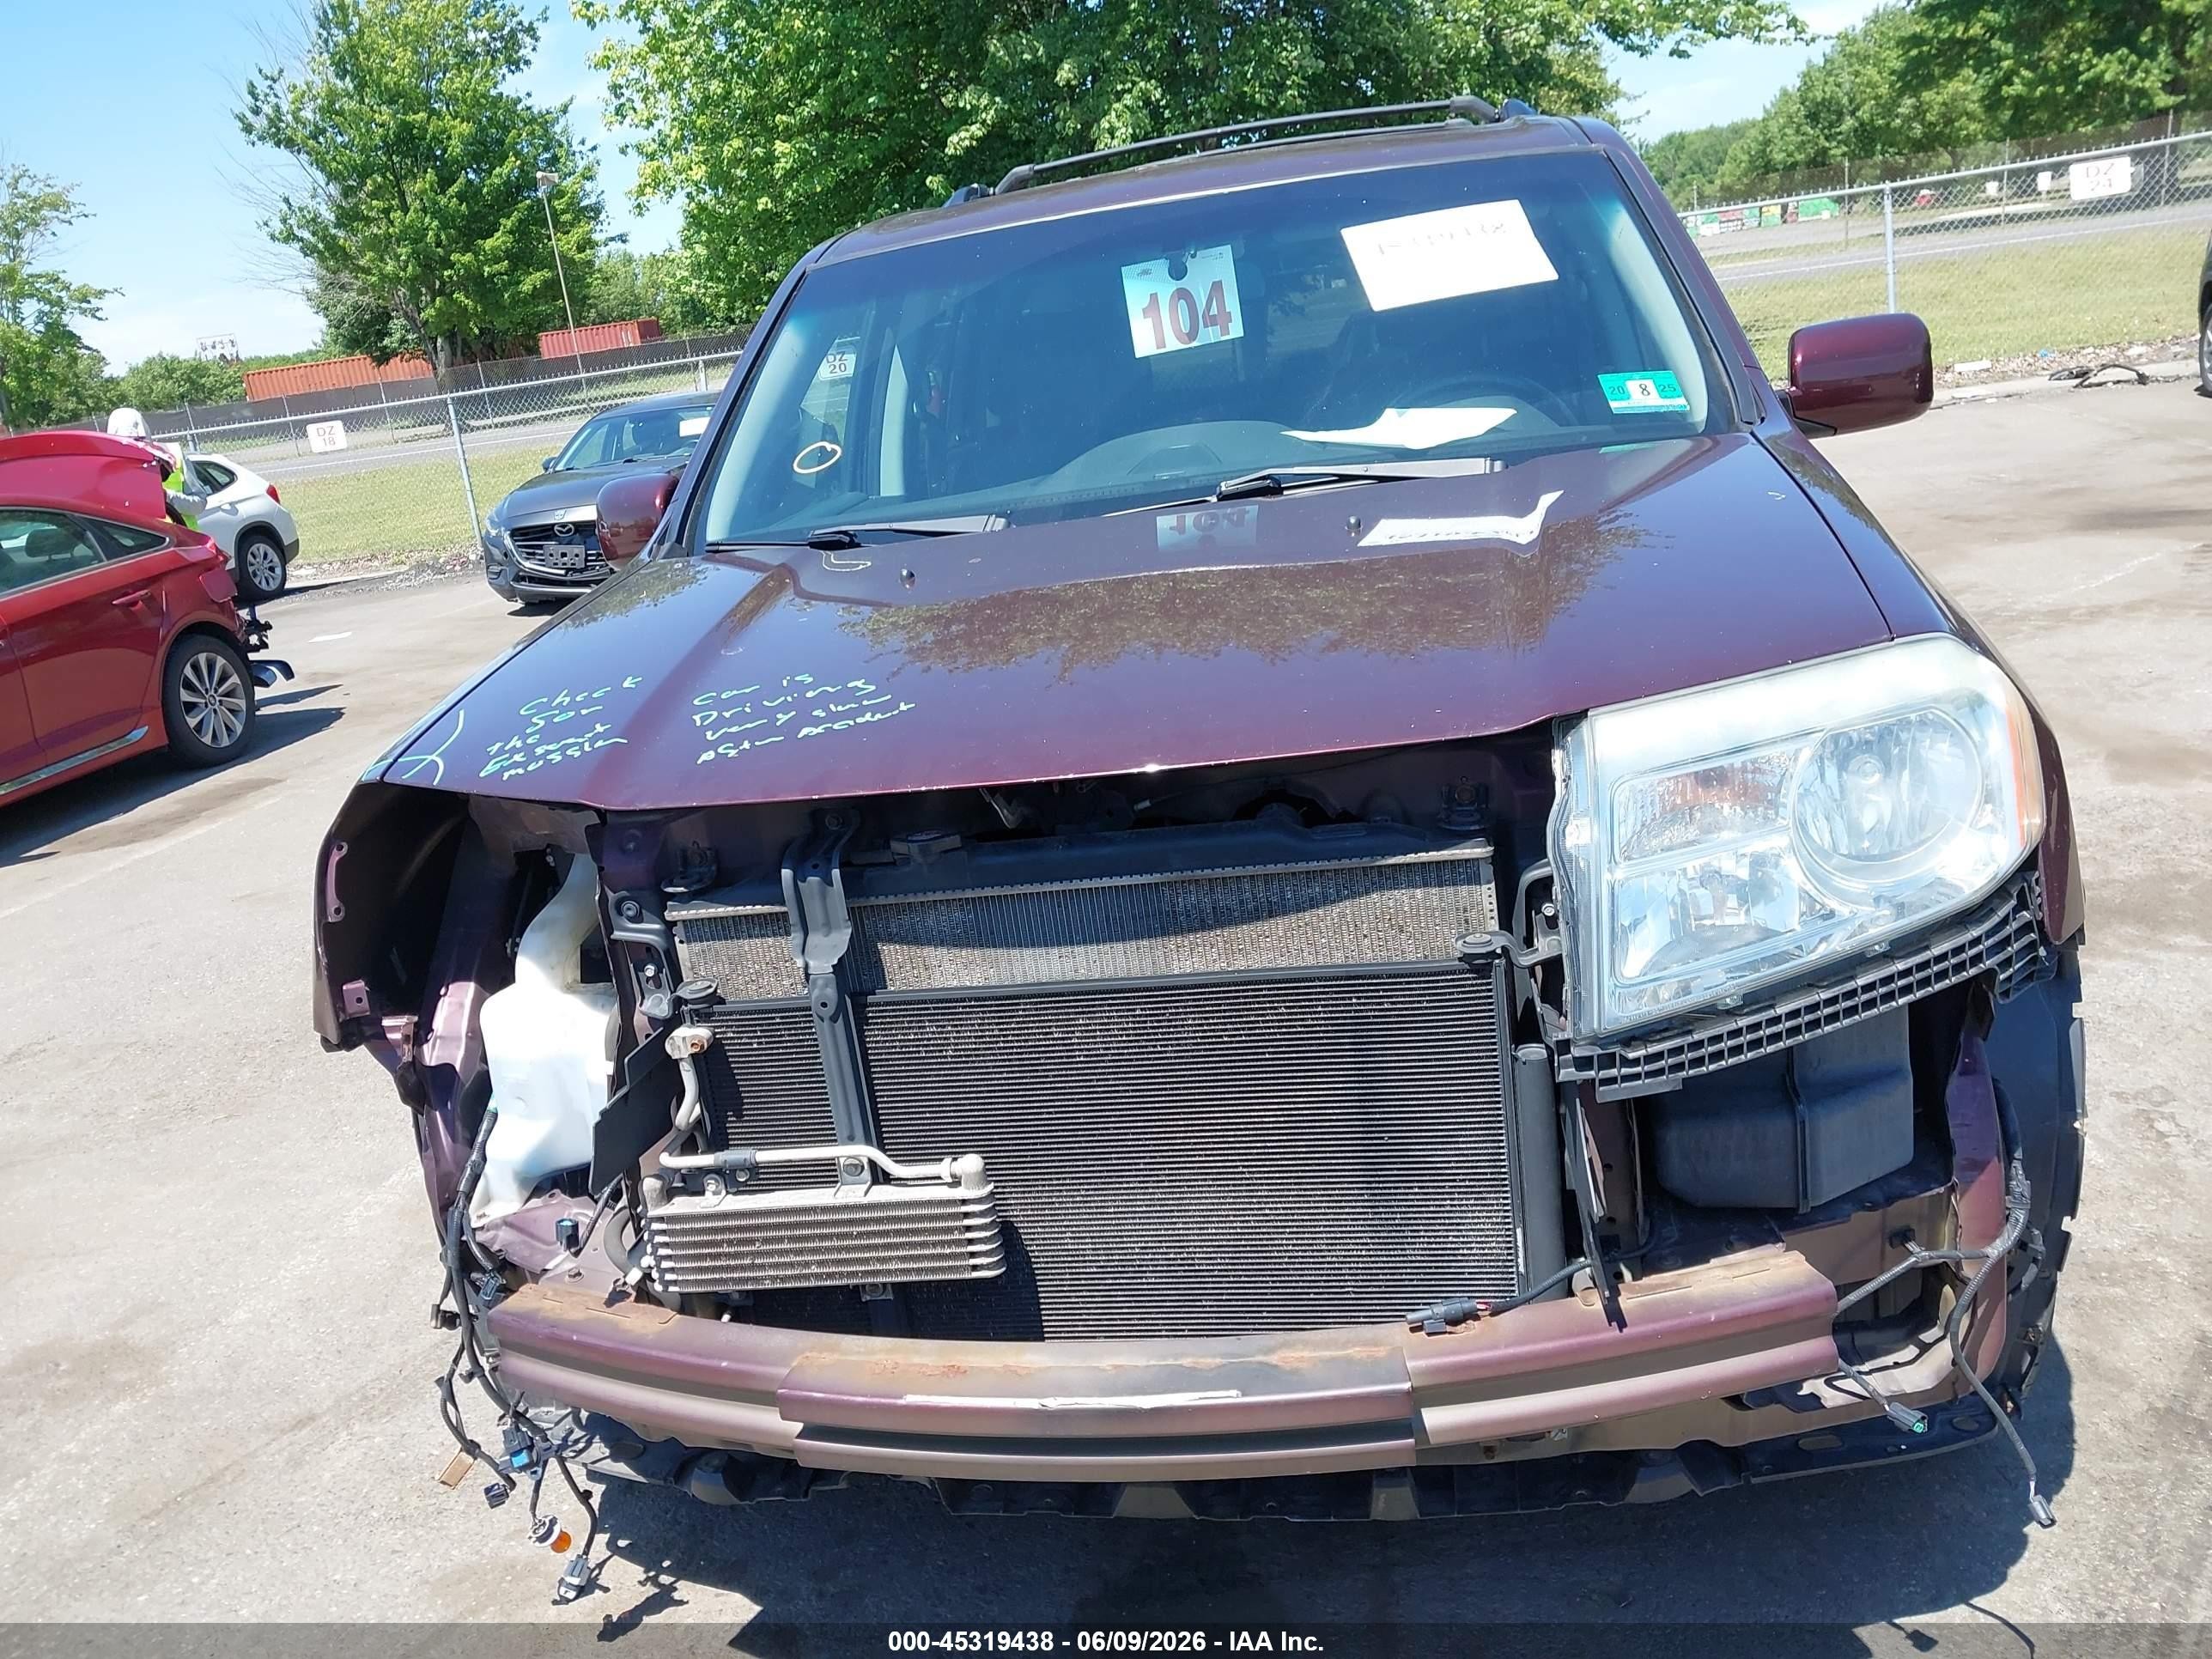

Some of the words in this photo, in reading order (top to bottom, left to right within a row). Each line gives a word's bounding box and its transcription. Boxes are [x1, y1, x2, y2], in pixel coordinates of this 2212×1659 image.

[1142, 279, 1232, 350] 104
[829, 362, 848, 374] 20
[1608, 385, 1626, 396] 20
[1638, 383, 1651, 397] 8
[1658, 384, 1677, 393] 25
[316, 425, 337, 437] DZ
[323, 436, 336, 447] 18
